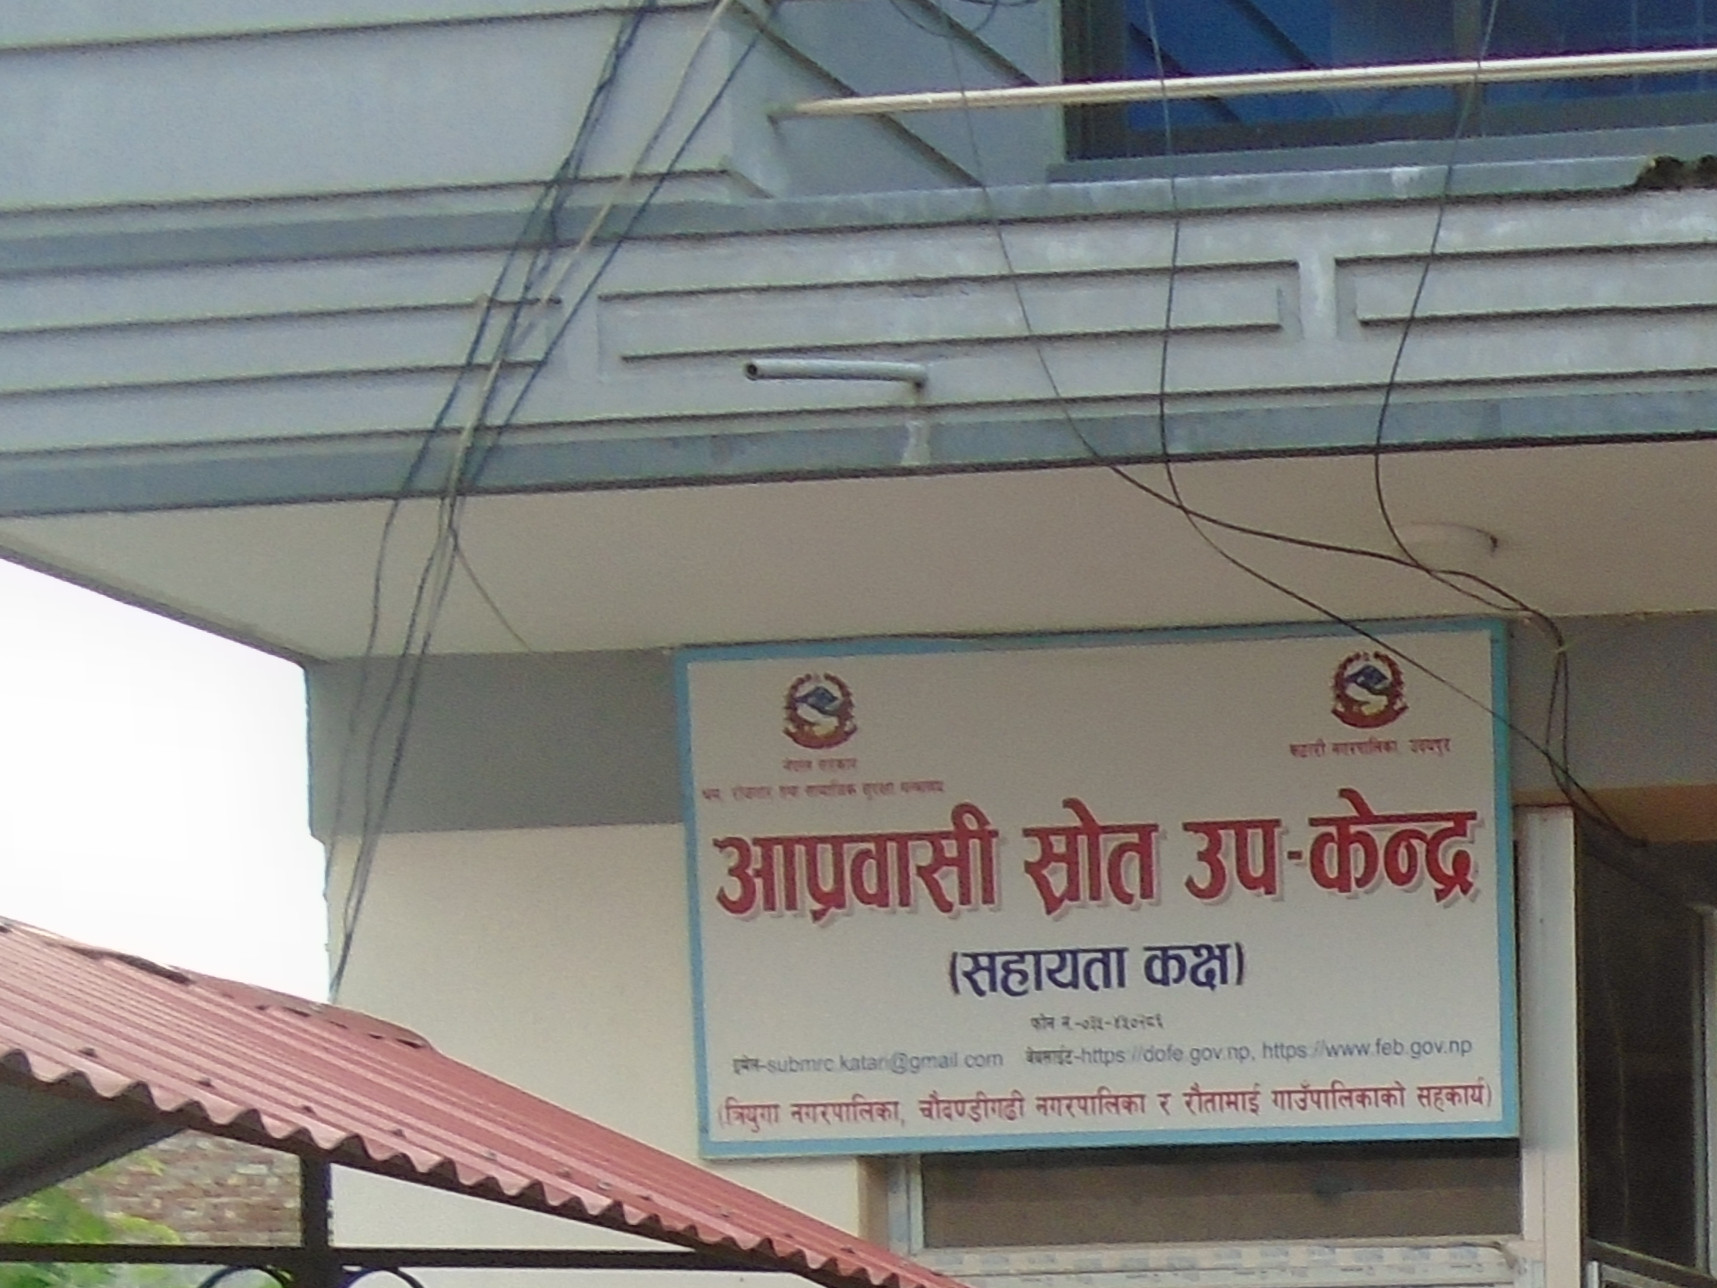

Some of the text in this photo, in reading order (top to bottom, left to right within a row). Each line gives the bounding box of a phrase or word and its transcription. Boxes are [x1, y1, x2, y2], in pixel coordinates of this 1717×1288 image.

[712, 788, 1480, 923] आप्रवासी स्रोत उप-केन्द्र
[950, 942, 1245, 998] (सहायता कक्ष)
[1036, 1085, 1147, 1117] नगरपालिका
